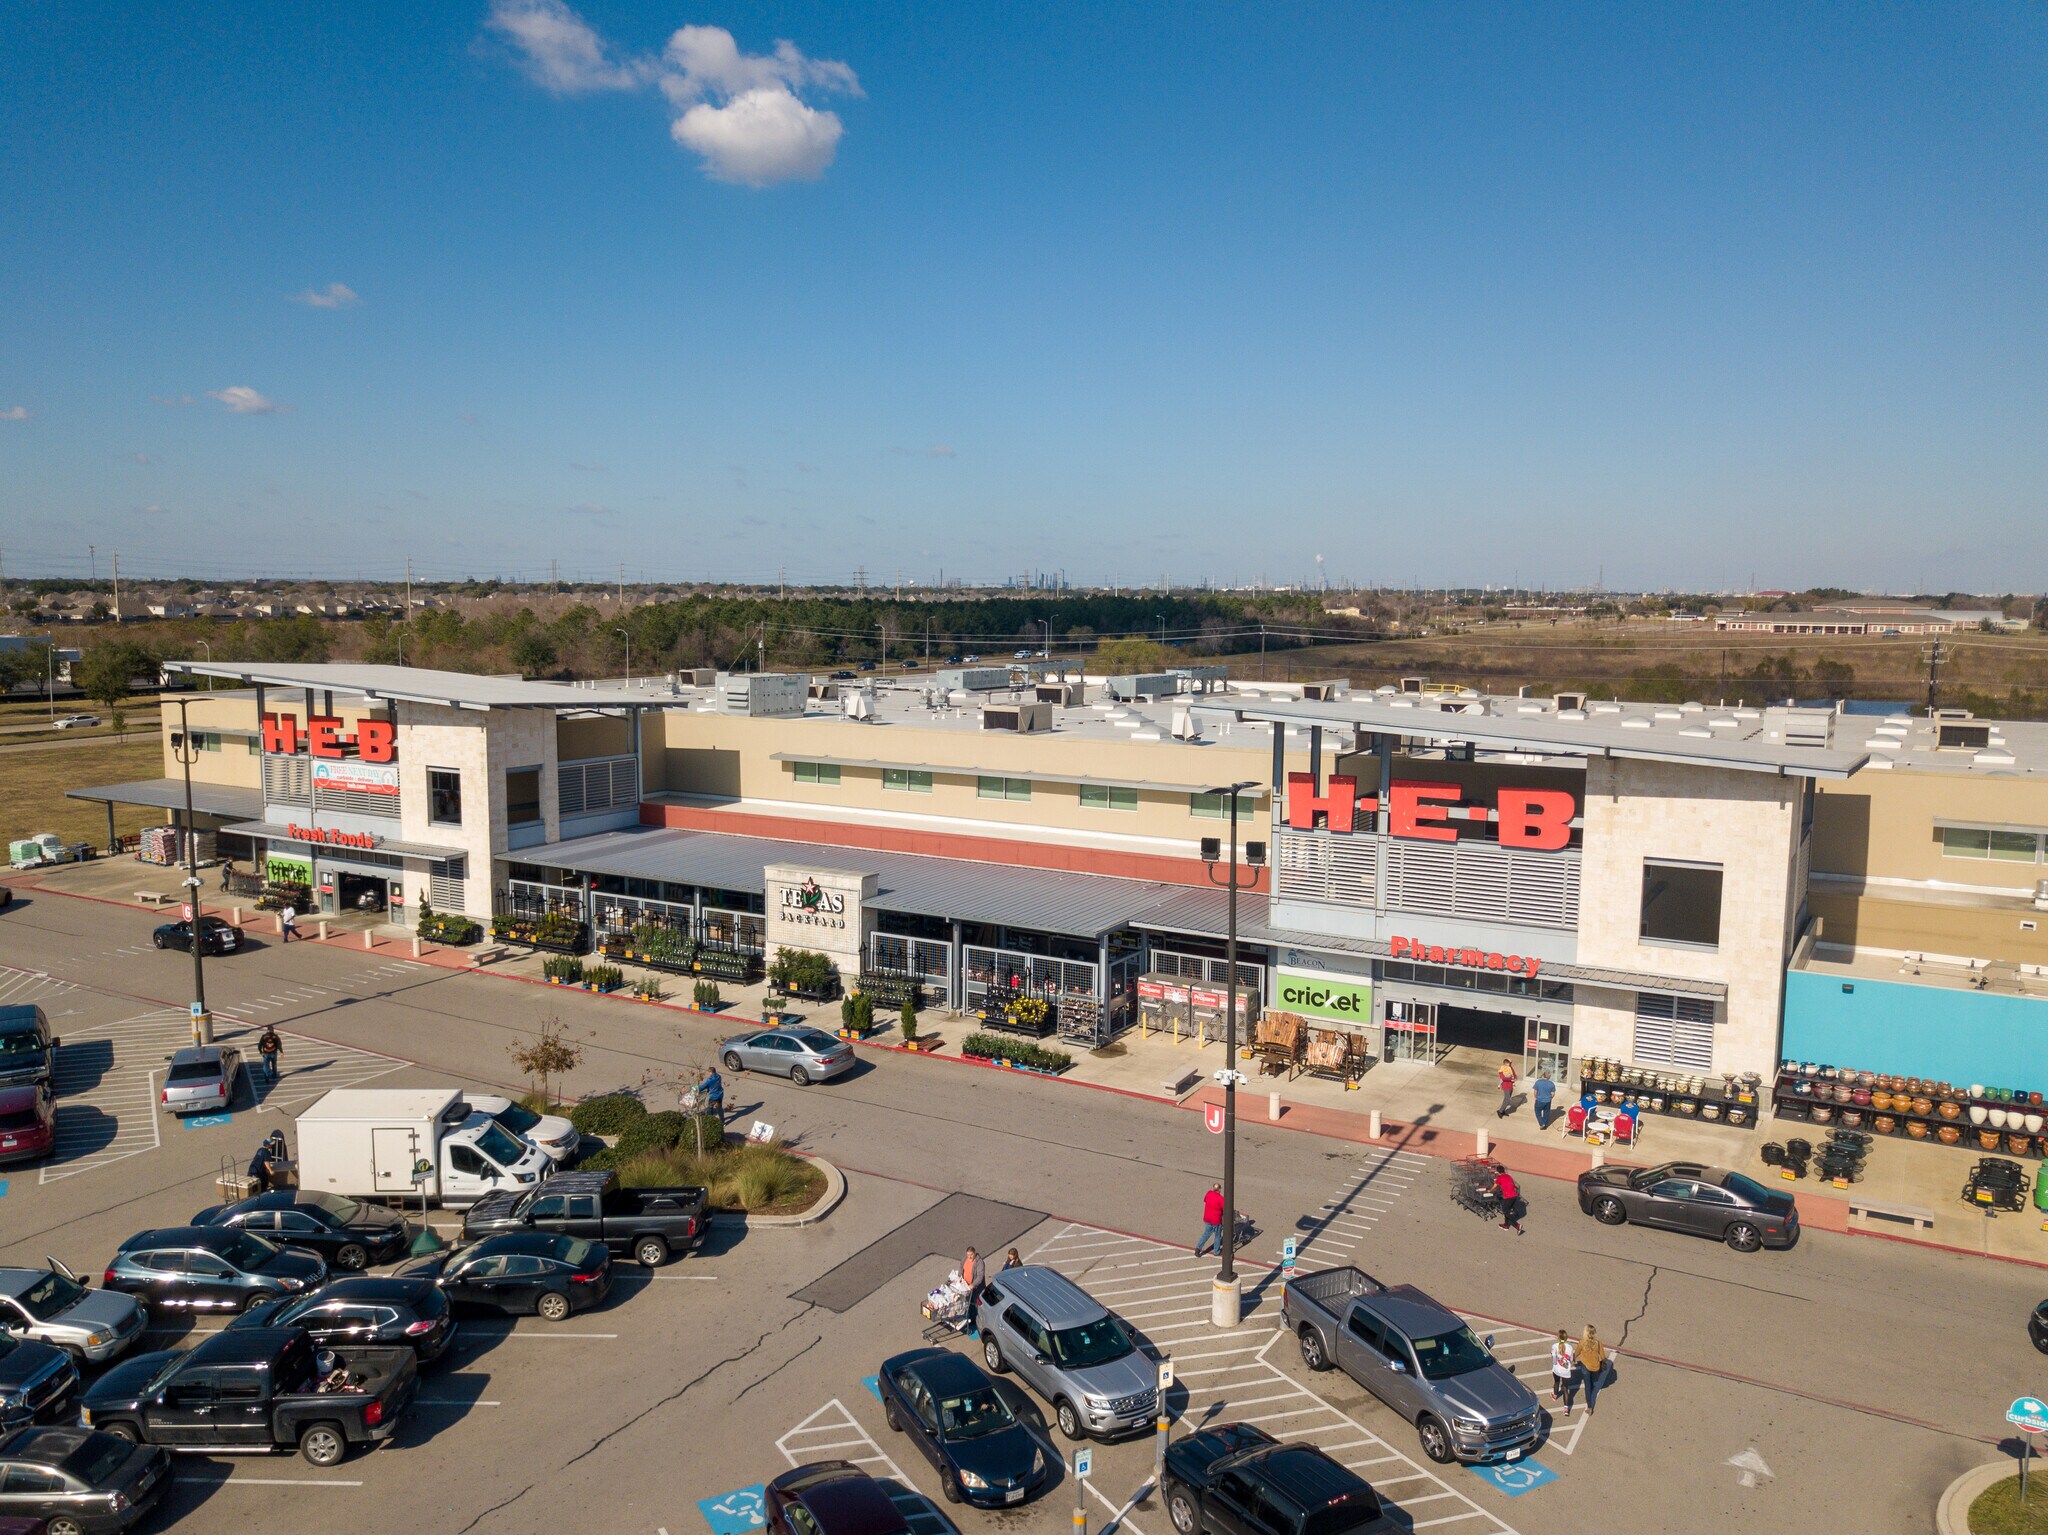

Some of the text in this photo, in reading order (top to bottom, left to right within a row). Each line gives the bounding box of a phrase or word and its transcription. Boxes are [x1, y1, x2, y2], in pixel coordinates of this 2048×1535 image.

[262, 711, 396, 763] H-E-B
[1288, 771, 1575, 850] H-E-B
[288, 822, 326, 842] Fresh
[330, 828, 374, 848] Foods
[779, 880, 844, 914] TEXAS
[185, 905, 191, 918] G
[779, 911, 845, 929] BACKYARD
[1289, 956, 1326, 970] BEACON
[1390, 935, 1542, 979] Pharmacy
[1140, 985, 1161, 994] Propane
[1193, 994, 1217, 1003] Propane
[1283, 986, 1361, 1013] cricket
[1209, 1109, 1220, 1128] J
[2008, 1413, 2048, 1428] curbsid
